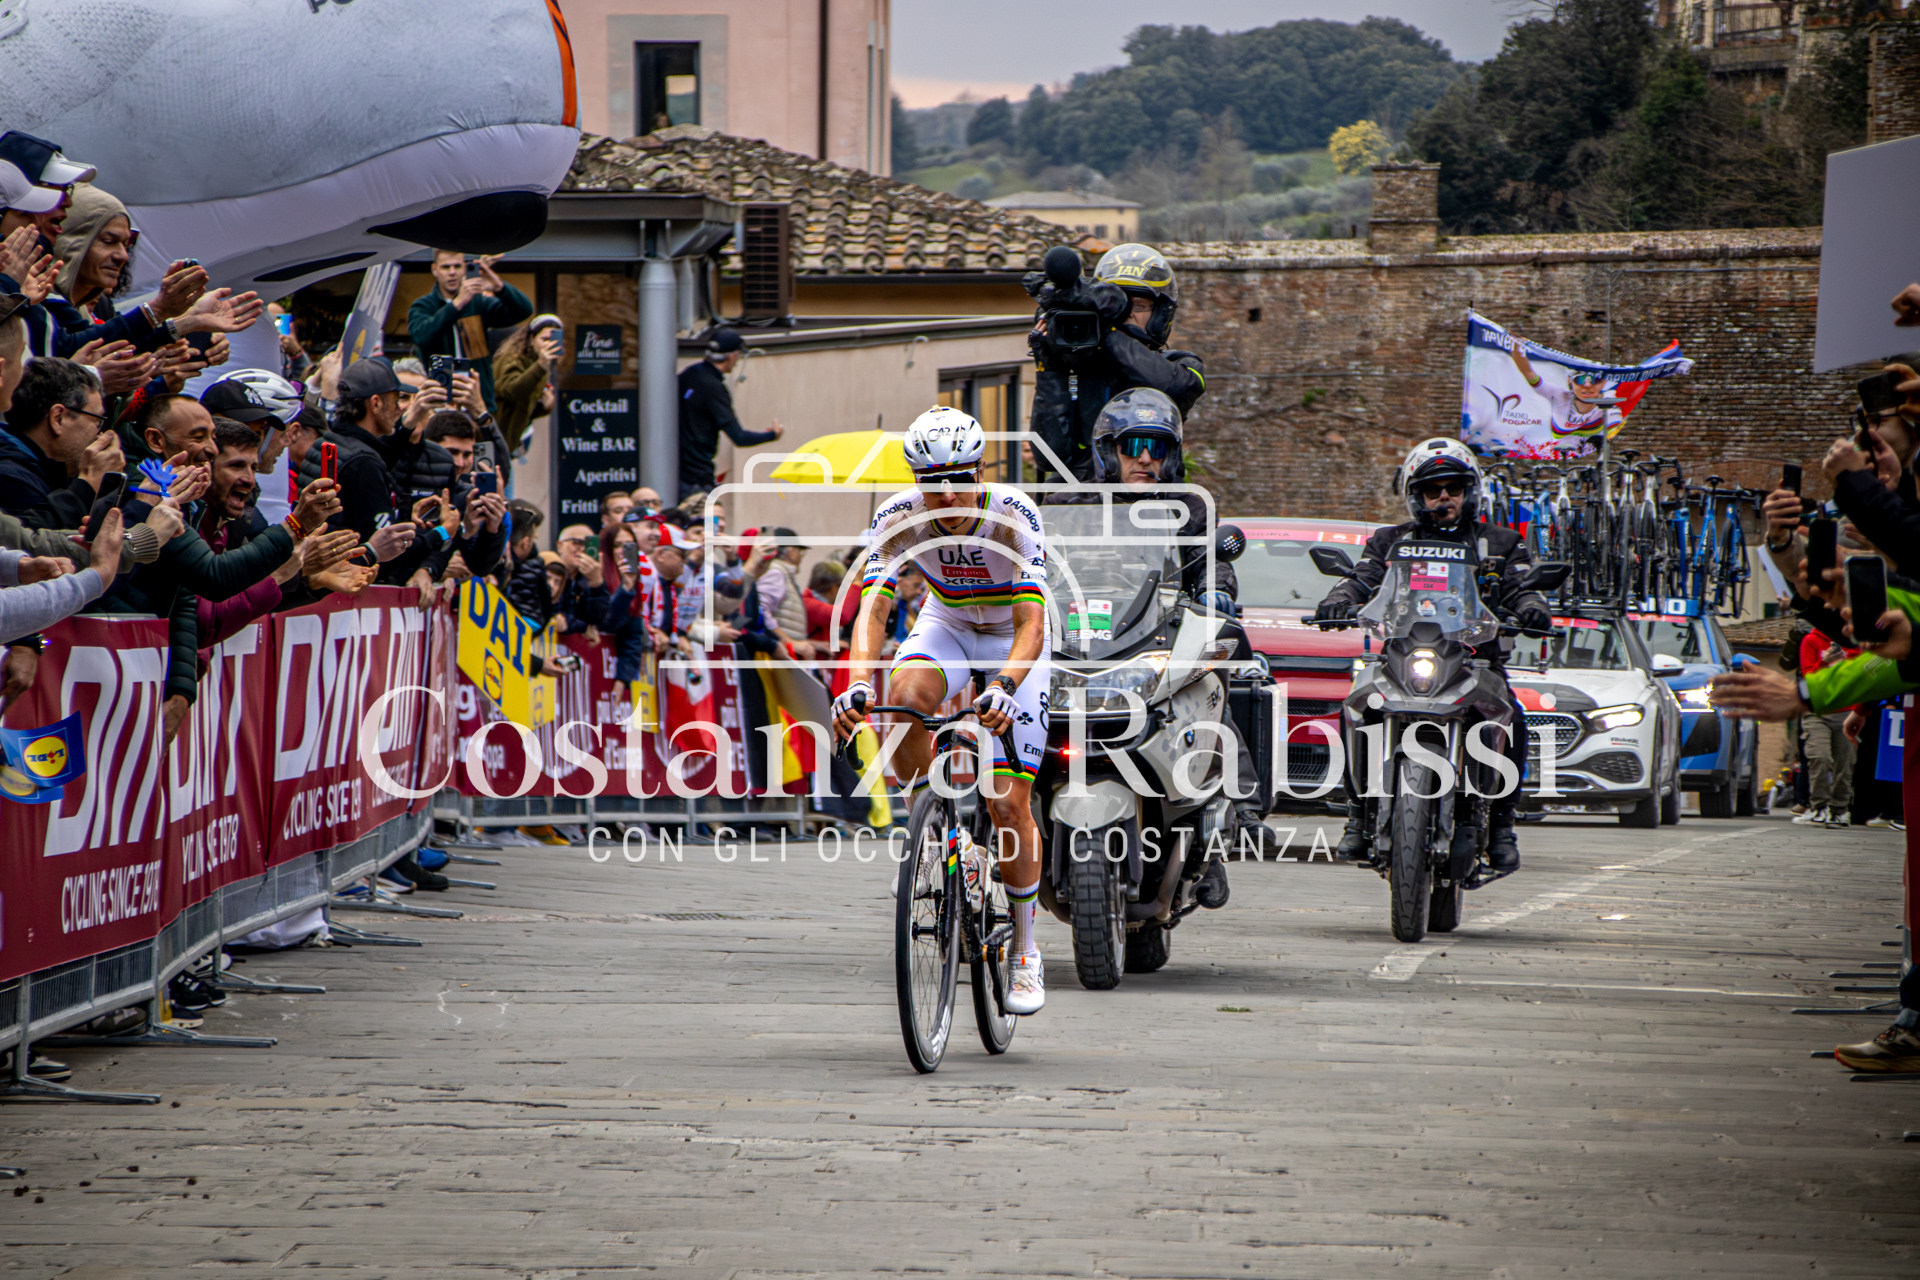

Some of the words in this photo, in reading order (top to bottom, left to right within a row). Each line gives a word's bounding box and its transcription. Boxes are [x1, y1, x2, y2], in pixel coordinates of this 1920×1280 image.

[1115, 265, 1145, 277] JAN
[569, 399, 629, 413] Cocktail
[590, 418, 606, 433] &
[562, 437, 598, 452] Wine
[601, 437, 636, 451] BAR
[575, 468, 637, 486] Aperitivi
[561, 500, 598, 514] Fritti
[877, 501, 913, 521] Analog
[1010, 500, 1040, 532] Analog
[938, 549, 986, 566] UAE
[1397, 546, 1466, 560] SUZUKI
[468, 576, 527, 677] DAI
[1080, 630, 1112, 640] EMG
[274, 607, 382, 782] DMT
[62, 869, 108, 934] CYCLING
